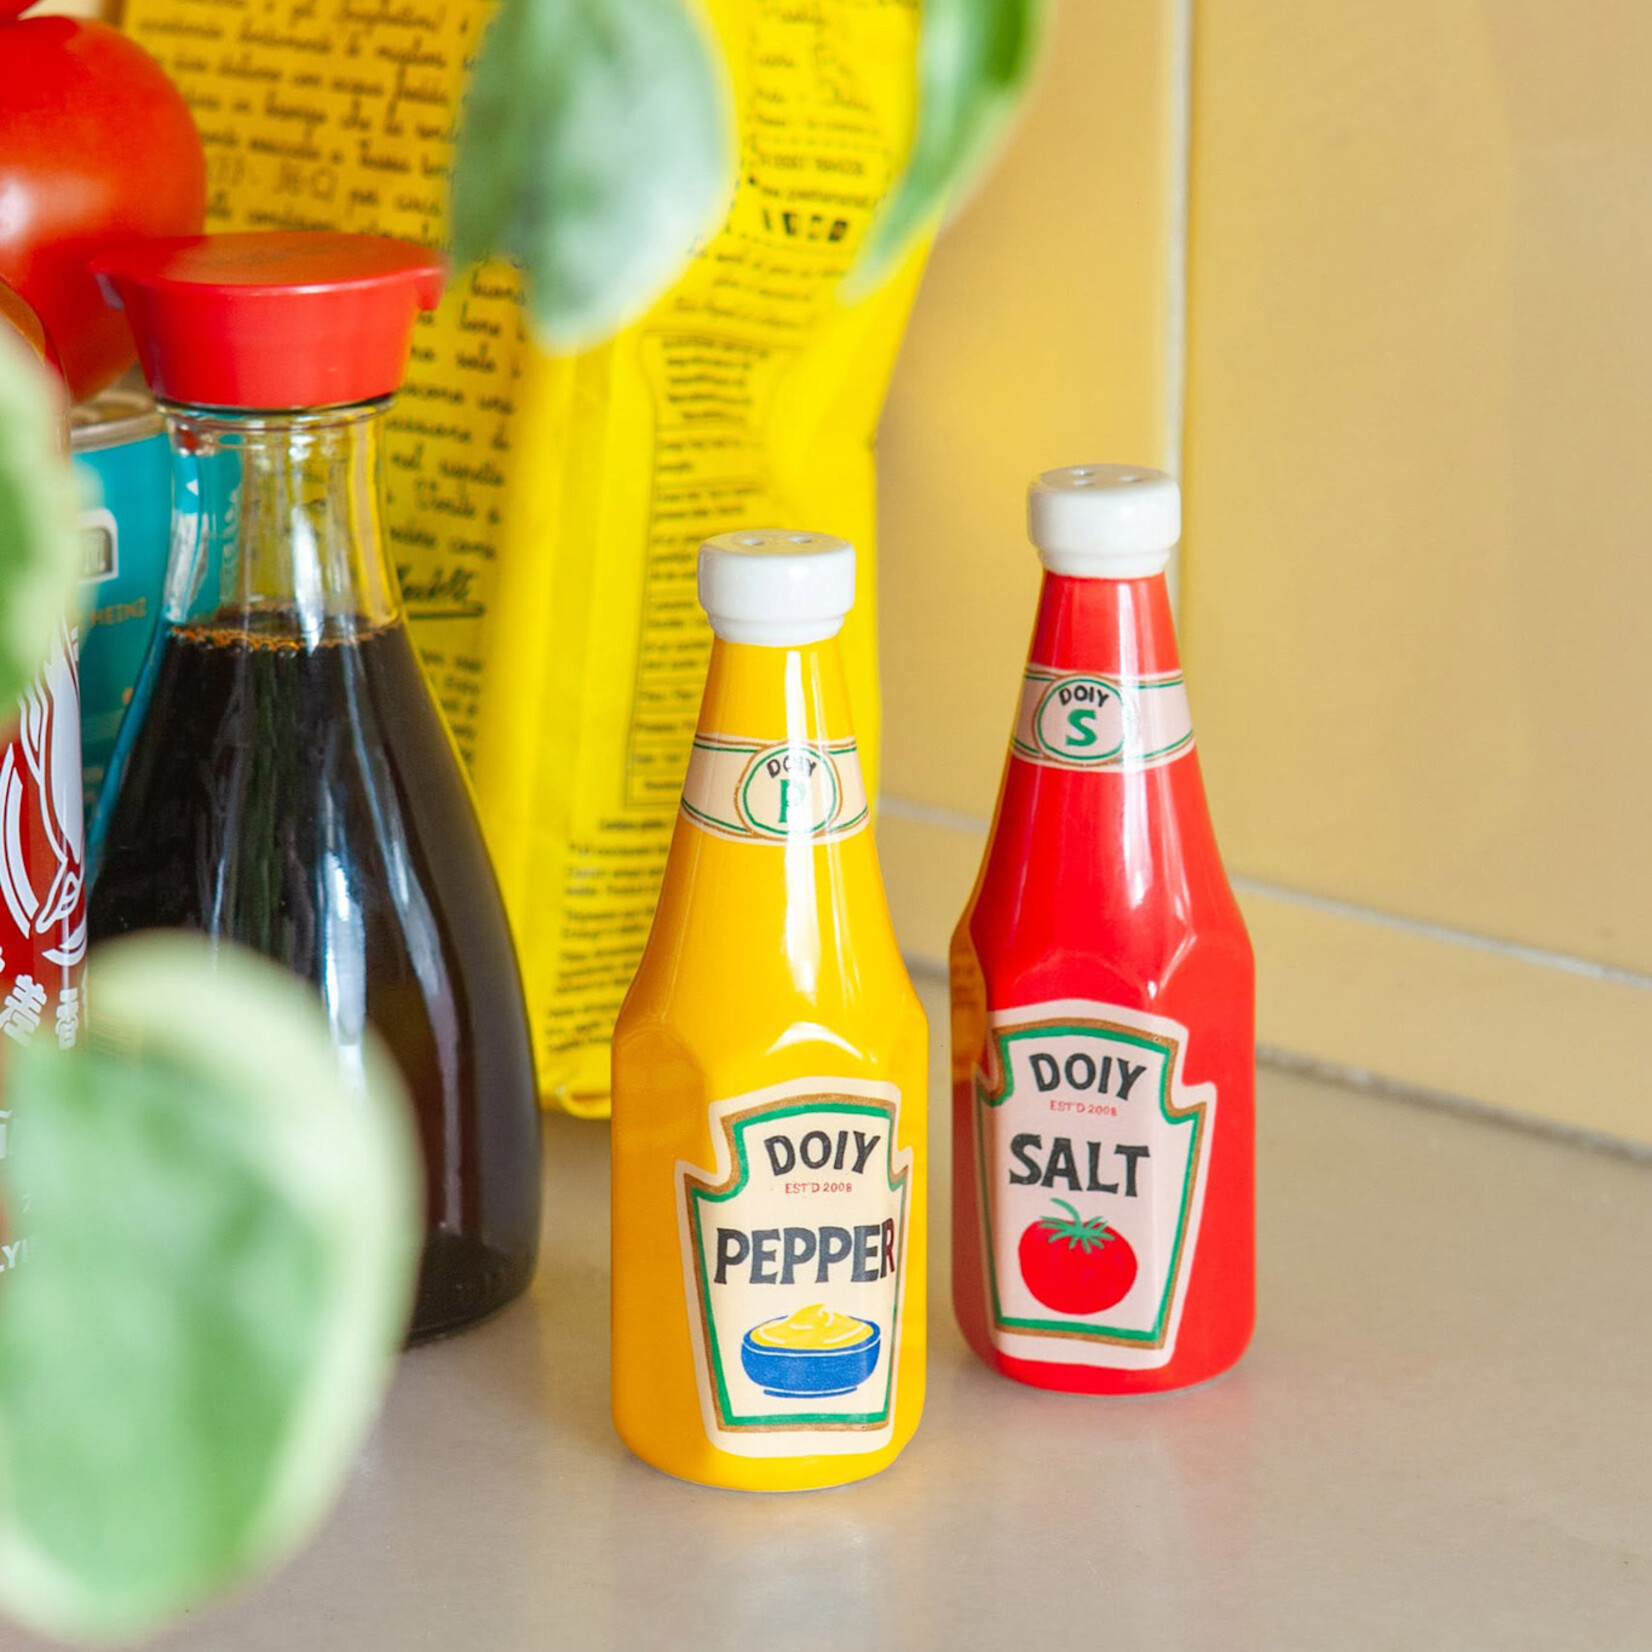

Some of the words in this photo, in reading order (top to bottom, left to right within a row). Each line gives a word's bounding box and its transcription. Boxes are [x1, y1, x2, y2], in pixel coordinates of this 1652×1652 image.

[1058, 685, 1110, 708] DOIY
[1065, 708, 1098, 747] S
[778, 778, 806, 823] P
[1028, 1053, 1147, 1101] DOIY
[1087, 1103, 1118, 1117] 2008
[764, 1130, 882, 1176] DOIY
[1008, 1133, 1151, 1198] SALT
[822, 1181, 853, 1195] 2008
[714, 1217, 895, 1285] PEPPER
